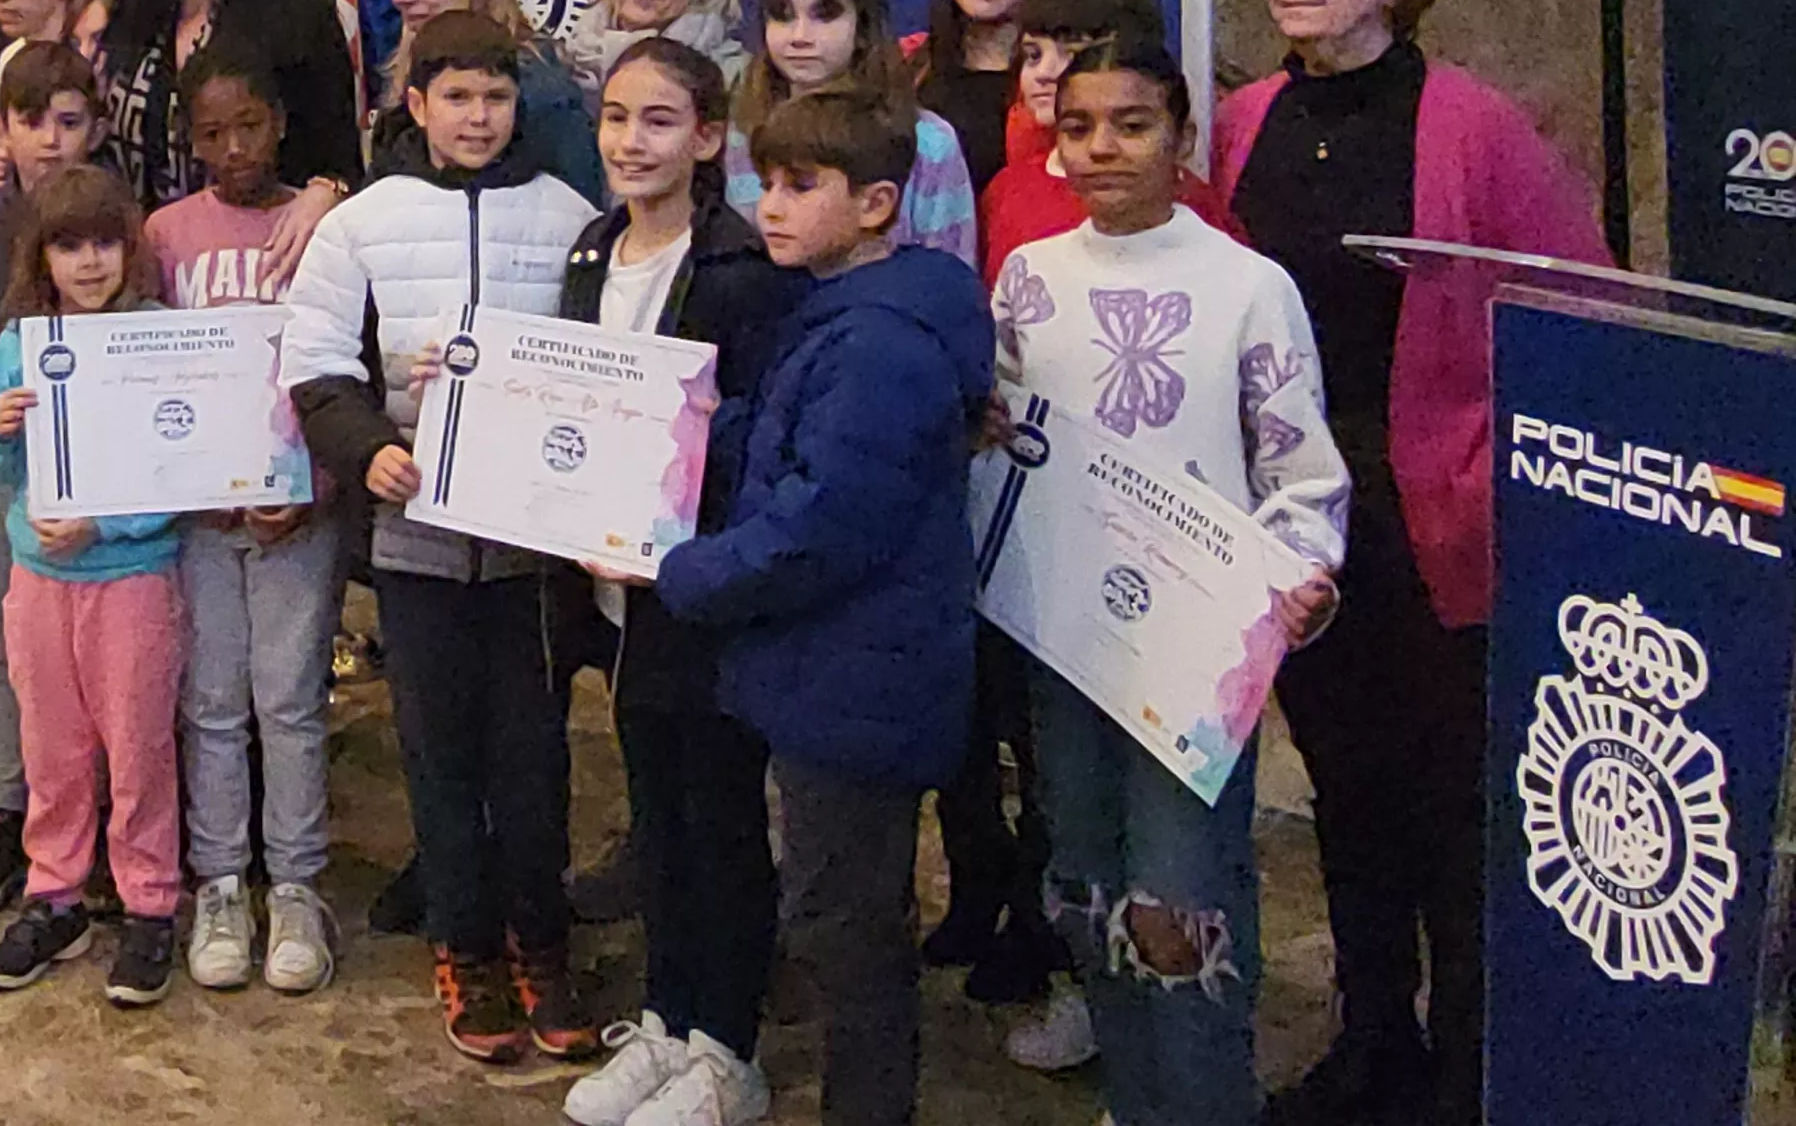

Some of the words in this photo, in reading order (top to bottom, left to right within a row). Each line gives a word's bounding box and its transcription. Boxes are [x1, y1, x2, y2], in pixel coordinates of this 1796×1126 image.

[208, 326, 229, 337] DE
[518, 334, 616, 361] CERTIFICADO
[618, 352, 640, 366] DE
[510, 348, 644, 382] RECONOCIMIENTO
[1100, 453, 1210, 529] CERTIFICADO
[1212, 522, 1236, 548] DE
[1510, 450, 1782, 559] NACIONAL
[1572, 844, 1666, 908] NACIONAL
